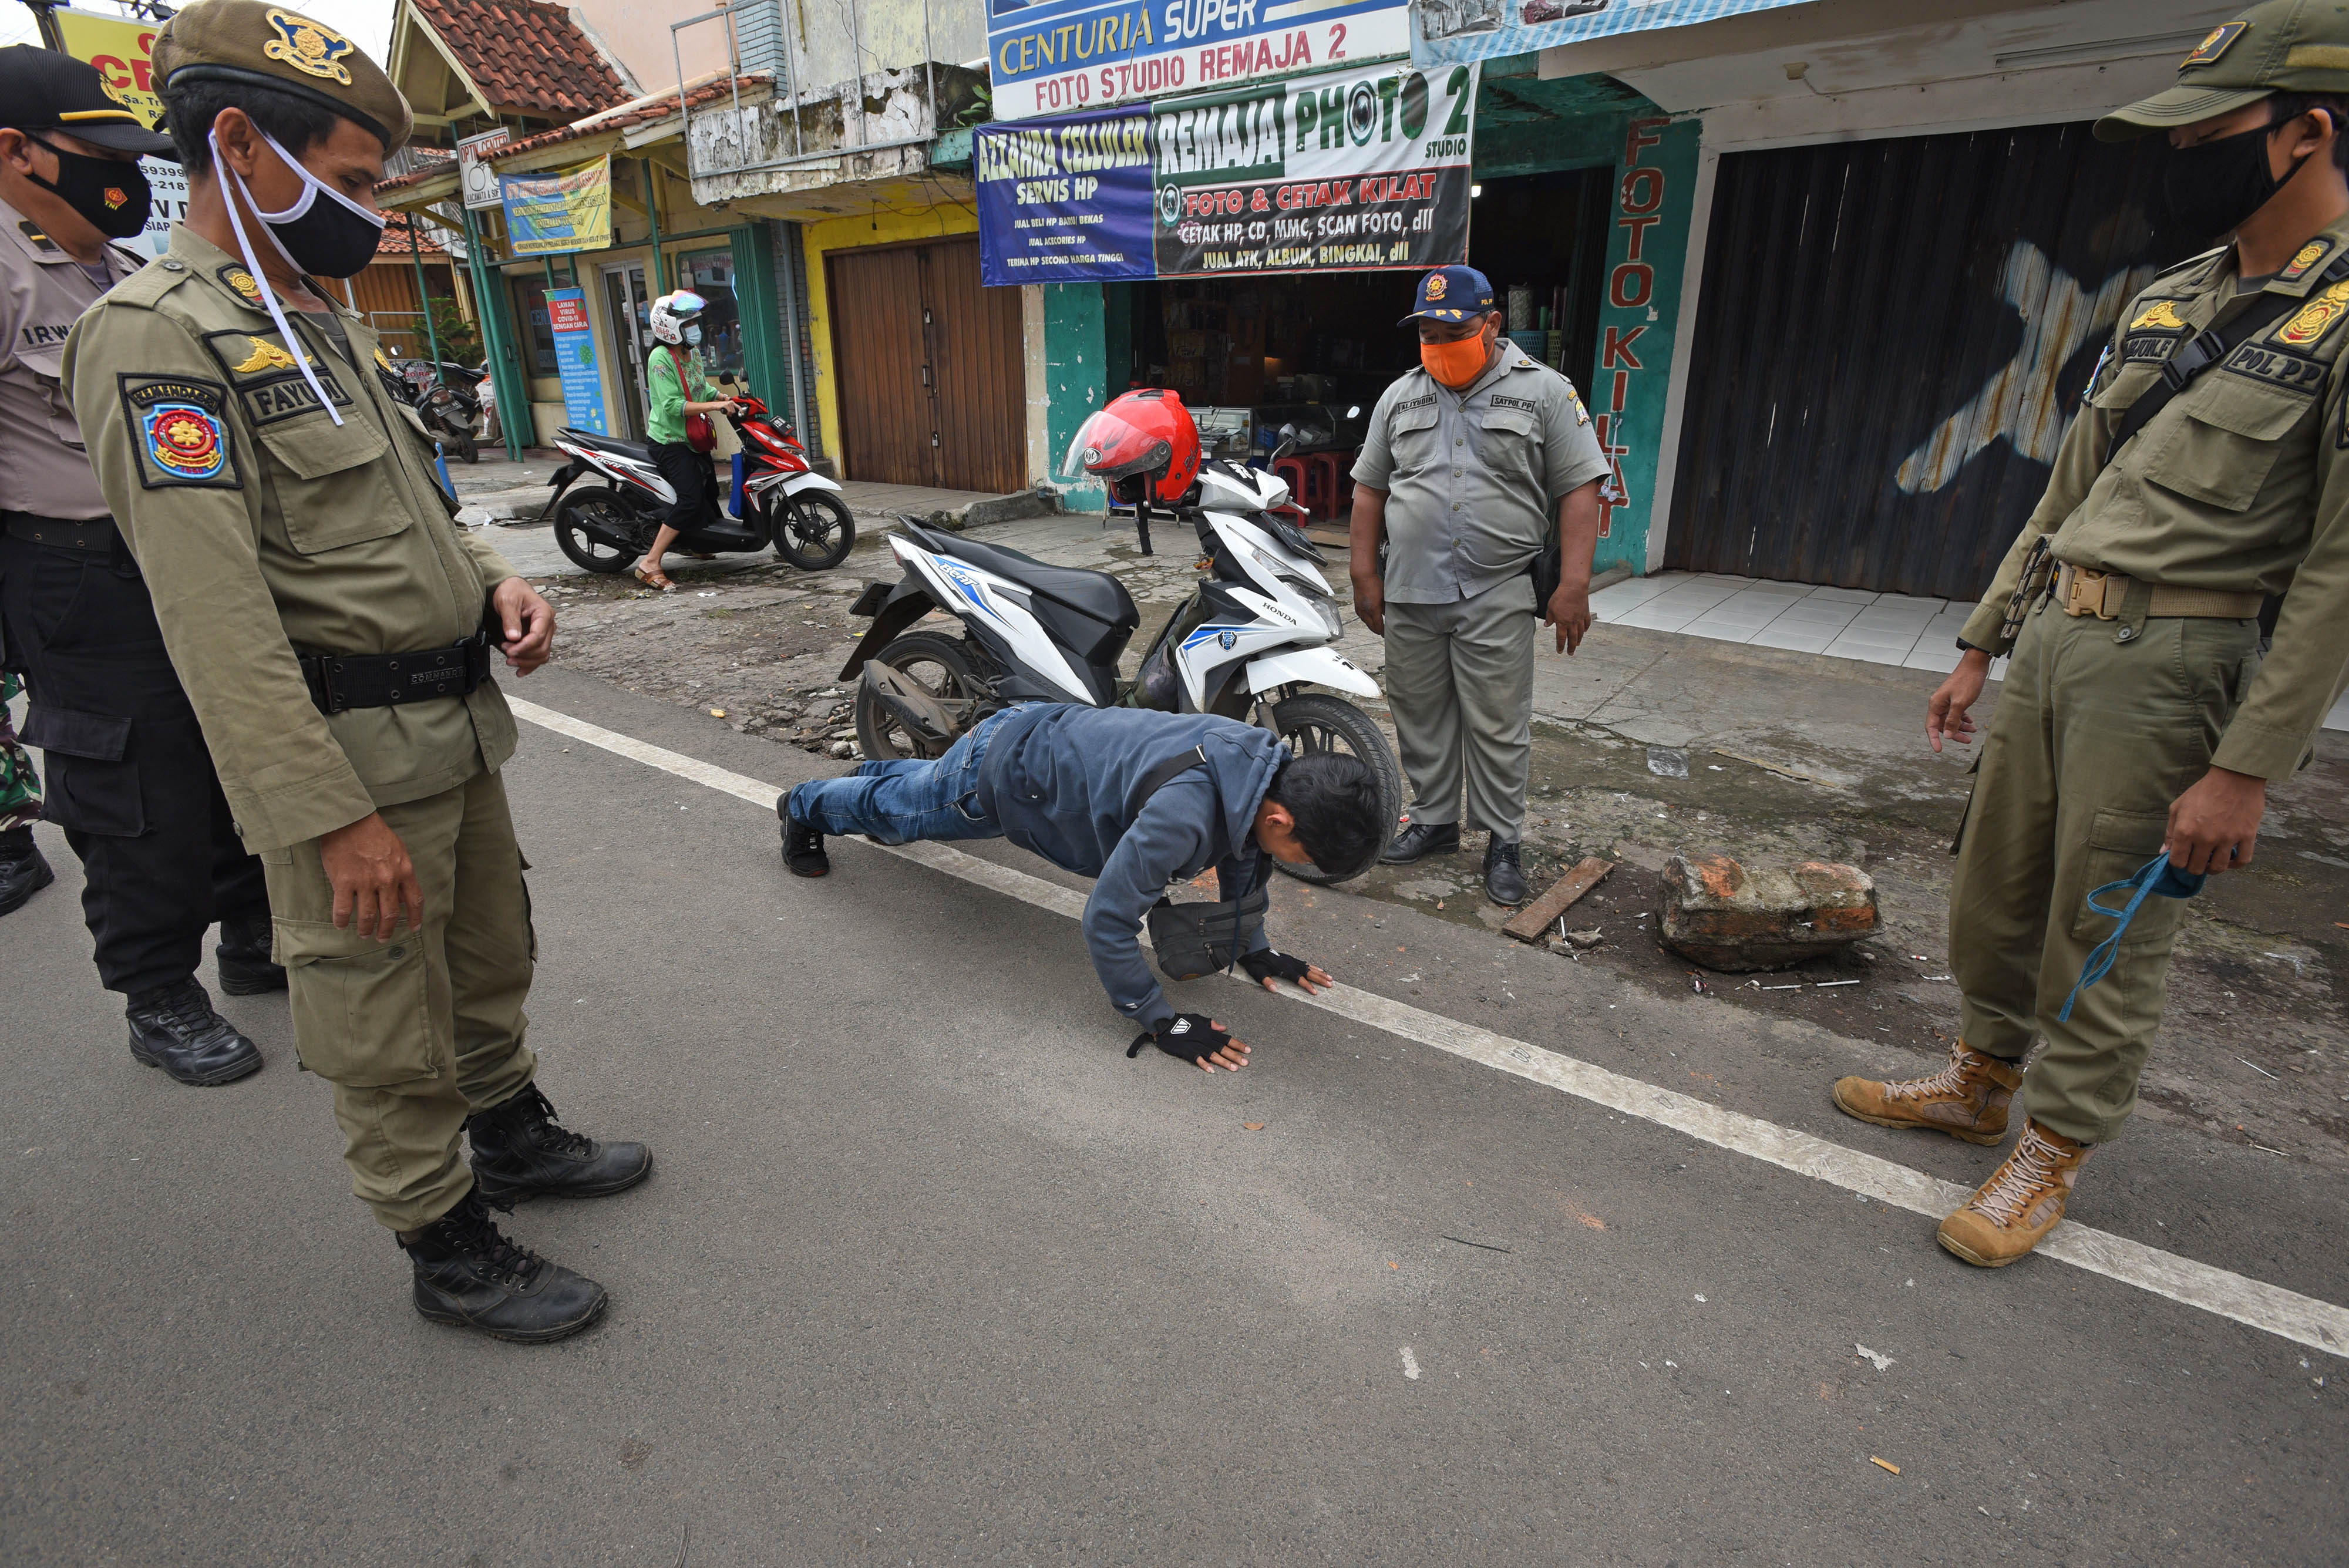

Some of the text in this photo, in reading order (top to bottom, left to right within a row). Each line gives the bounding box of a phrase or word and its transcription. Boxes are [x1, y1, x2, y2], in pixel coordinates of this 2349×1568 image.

[999, 0, 1257, 75] CENTURIA SUPER
[1035, 23, 1347, 111] FOTO STUDIO REMAJA 2
[1160, 98, 1281, 176] REMAJA
[1442, 65, 1469, 136] 2
[978, 116, 1149, 183] AZZAHRA CELLULER
[1425, 137, 1466, 159] STUDIO
[1017, 176, 1098, 206] SERVIS HP
[1186, 173, 1436, 217] FOTO & CETAK KILAT
[105, 200, 118, 210] TNI
[1609, 117, 1671, 308] FOTO
[1015, 219, 1030, 229] JUAL
[1031, 218, 1045, 228] BELI
[1046, 217, 1057, 227] HP
[1079, 214, 1103, 224] BEKAS
[1182, 224, 1220, 245] CETAK
[1224, 223, 1245, 247] HP,
[1274, 217, 1314, 243] MMC,
[1317, 214, 1358, 236] SCAN
[1361, 211, 1408, 238] FOTO,
[1412, 208, 1434, 233] dll
[1029, 235, 1086, 247] JUAL ACECORIES HP
[1007, 253, 1124, 267] TERIMA HP SECOND HARGA TINGGI
[1203, 241, 1409, 270] JUAL ATK, ALBUM, BINGKAI, dll
[22, 325, 73, 345] IRW
[2232, 349, 2322, 385] POL PP
[1401, 395, 1434, 411] ALIYUDIN
[1495, 398, 1532, 409] SATPOL PP
[776, 459, 795, 469] HONDA
[1262, 601, 1298, 626] HONDA
